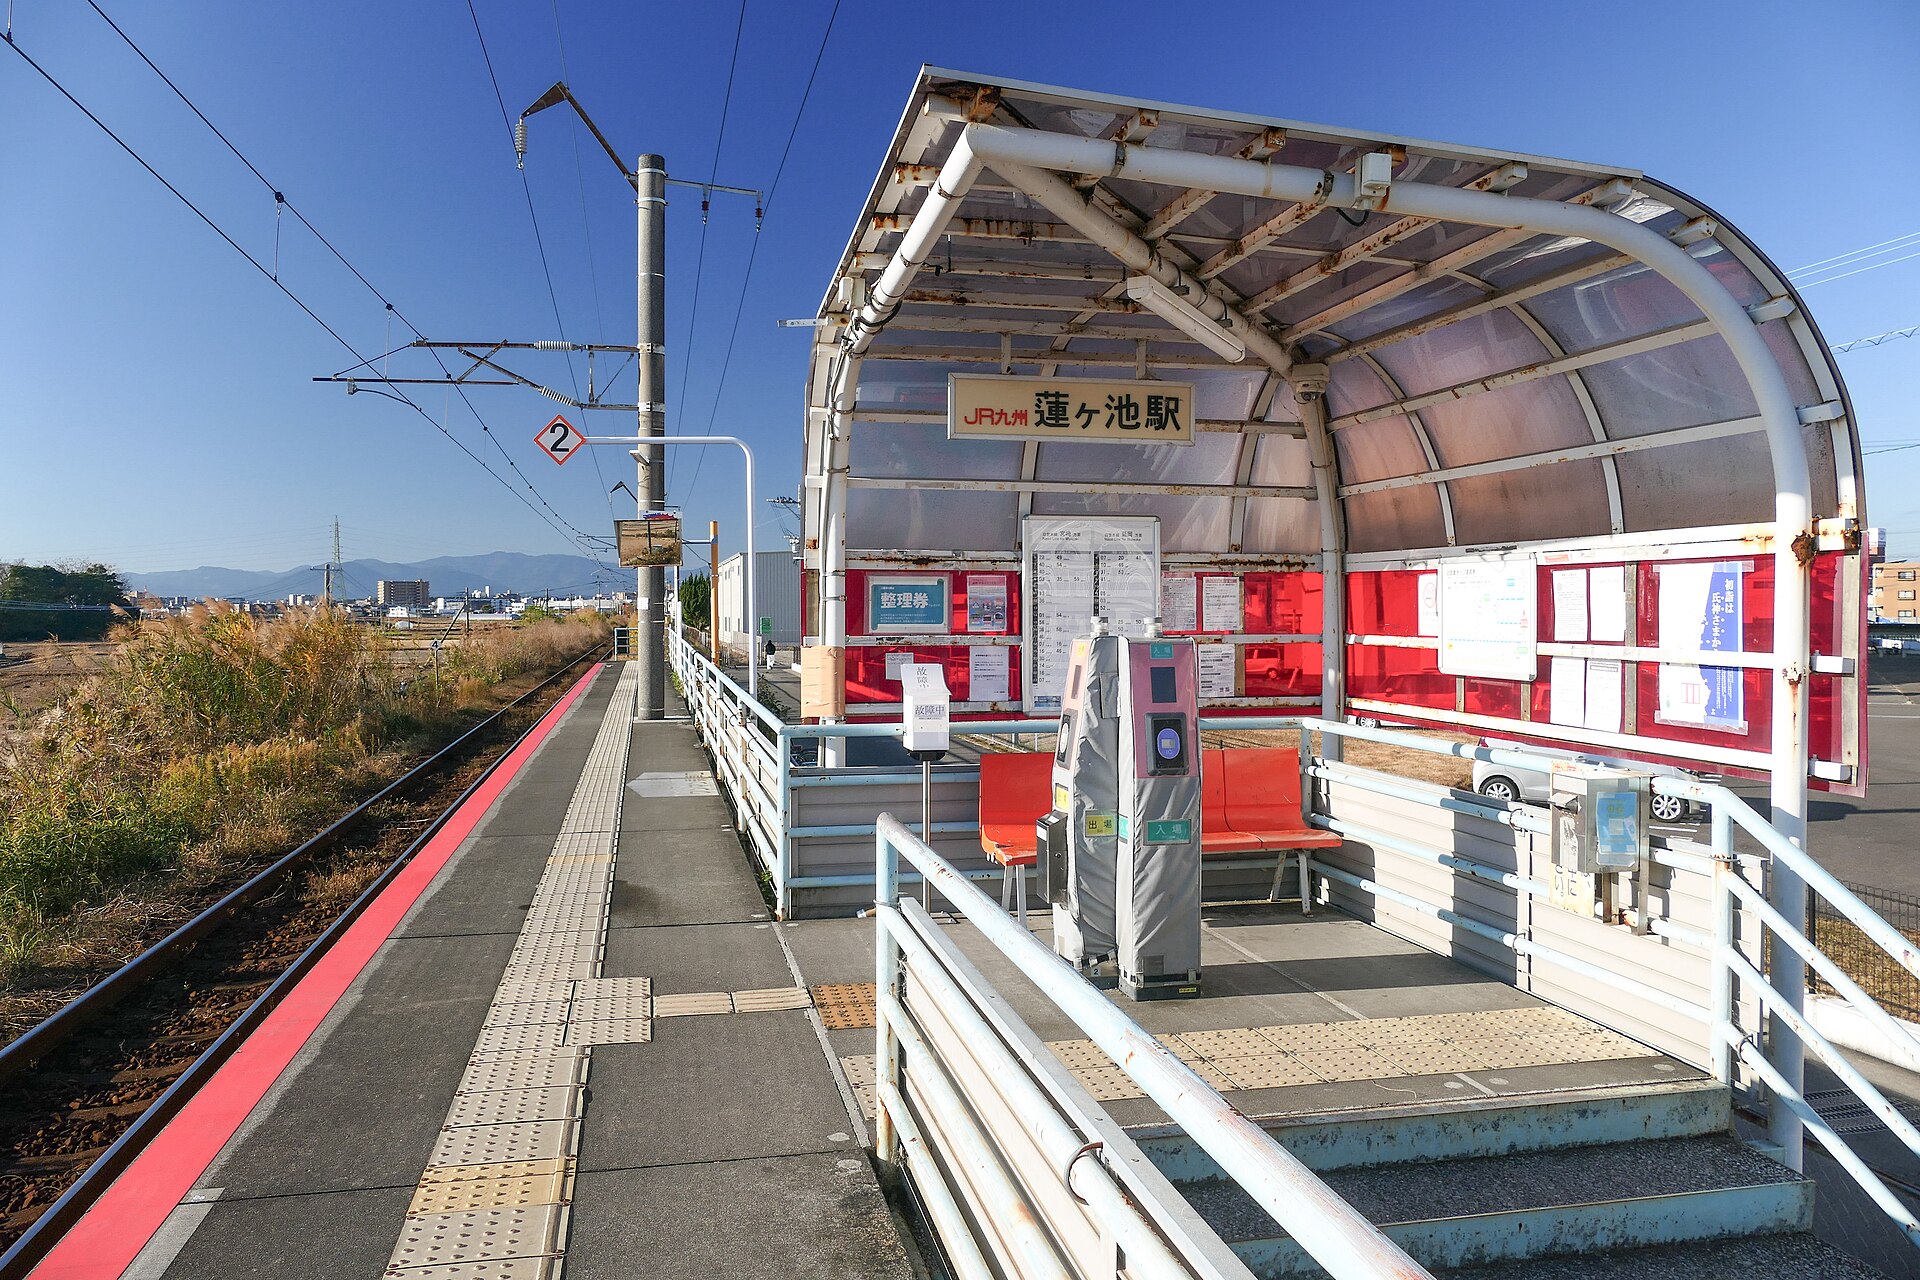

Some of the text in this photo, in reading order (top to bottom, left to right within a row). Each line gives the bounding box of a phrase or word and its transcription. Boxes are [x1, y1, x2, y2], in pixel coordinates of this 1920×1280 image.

[964, 407, 1028, 427] JR九州
[549, 422, 570, 453] 2
[880, 592, 929, 609] 整理券
[1711, 592, 1722, 651] 氏神さまか
[915, 704, 945, 715] 故障中
[1088, 819, 1112, 830] 出場
[1155, 824, 1182, 835] 入場
